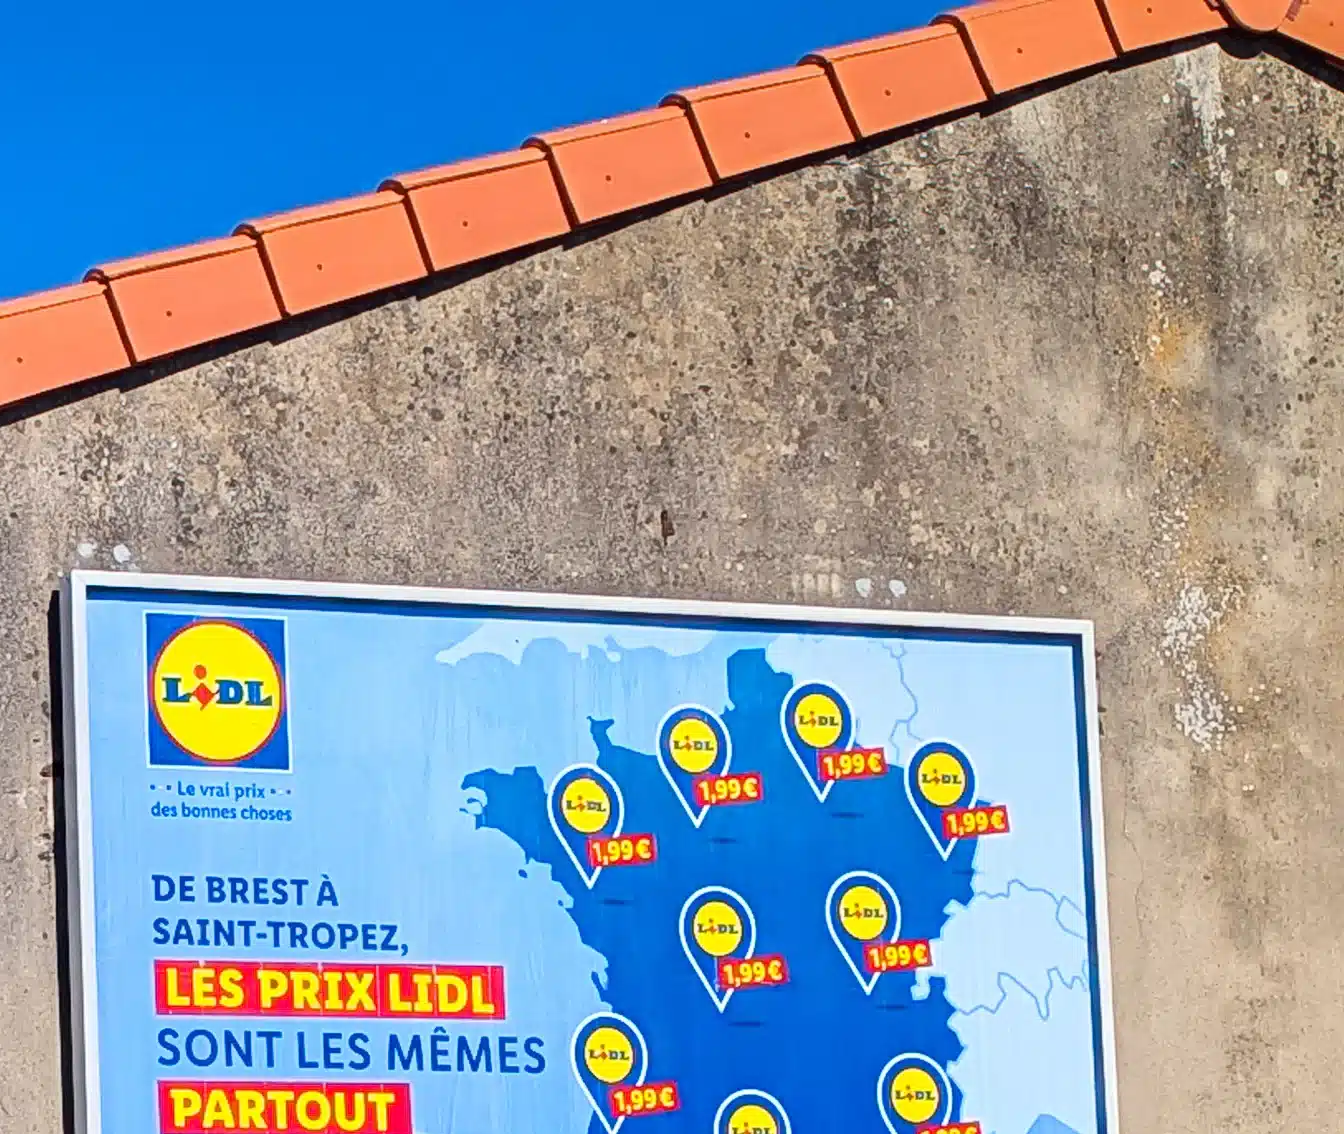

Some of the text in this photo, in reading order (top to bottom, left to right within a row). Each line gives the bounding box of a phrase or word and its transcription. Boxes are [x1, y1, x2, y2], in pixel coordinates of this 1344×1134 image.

[177, 781, 265, 801] Le vrai prix
[151, 802, 293, 821] des bonnes choses
[152, 873, 339, 907] DE BREST À
[152, 918, 409, 956] SAINT-TROPEZ,
[165, 967, 495, 1014] LES PRIX LIDL
[156, 1026, 546, 1074] SONT LES MÊMES
[170, 1088, 395, 1131] PARTOUT
